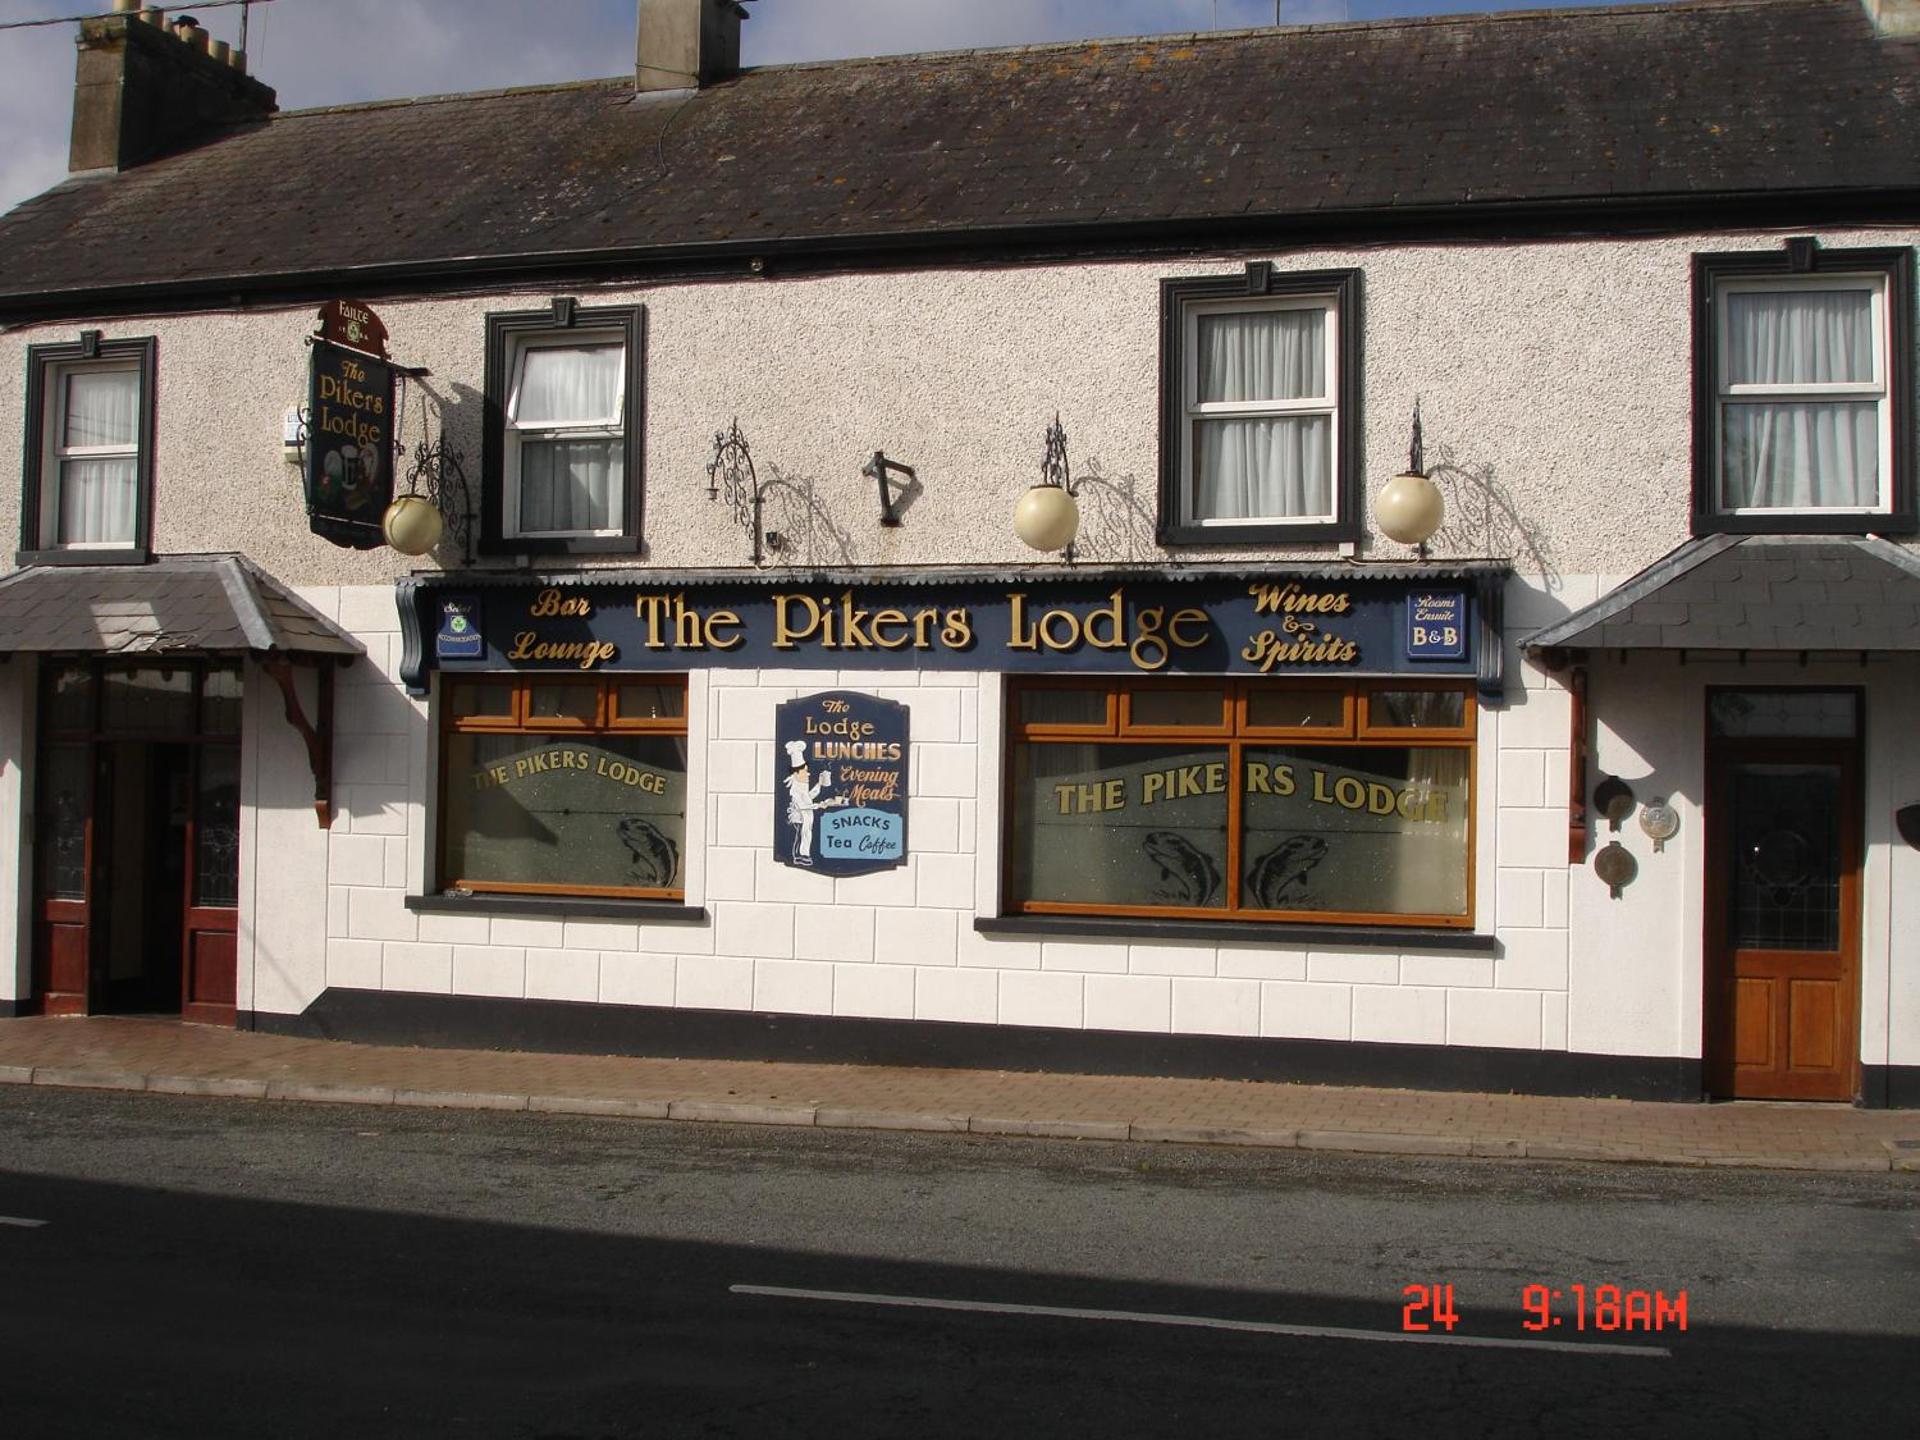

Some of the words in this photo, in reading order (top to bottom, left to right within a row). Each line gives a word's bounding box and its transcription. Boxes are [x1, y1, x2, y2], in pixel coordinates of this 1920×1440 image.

[342, 360, 366, 383] The
[320, 374, 383, 414] Pikers
[321, 406, 381, 449] Lodge
[530, 588, 591, 617] Bar
[1248, 583, 1351, 613] Wines
[635, 593, 741, 648] The
[771, 590, 972, 648] Pikers
[1005, 587, 1210, 671] Lodge
[1281, 614, 1316, 634] &
[1412, 626, 1458, 647] B&B
[507, 631, 616, 669] Lounge
[1241, 629, 1357, 673] Spirits
[822, 699, 850, 713] The
[805, 715, 875, 741] Lodge
[812, 741, 902, 761] LUNCHES
[515, 750, 590, 778] PIKERS
[596, 756, 667, 795] LODGE
[840, 764, 899, 788] Evening
[849, 784, 898, 808] Meals
[1055, 778, 1126, 815] THE
[832, 815, 891, 831] SNACKS
[826, 834, 853, 849] Tea
[858, 834, 897, 855] Coffee
